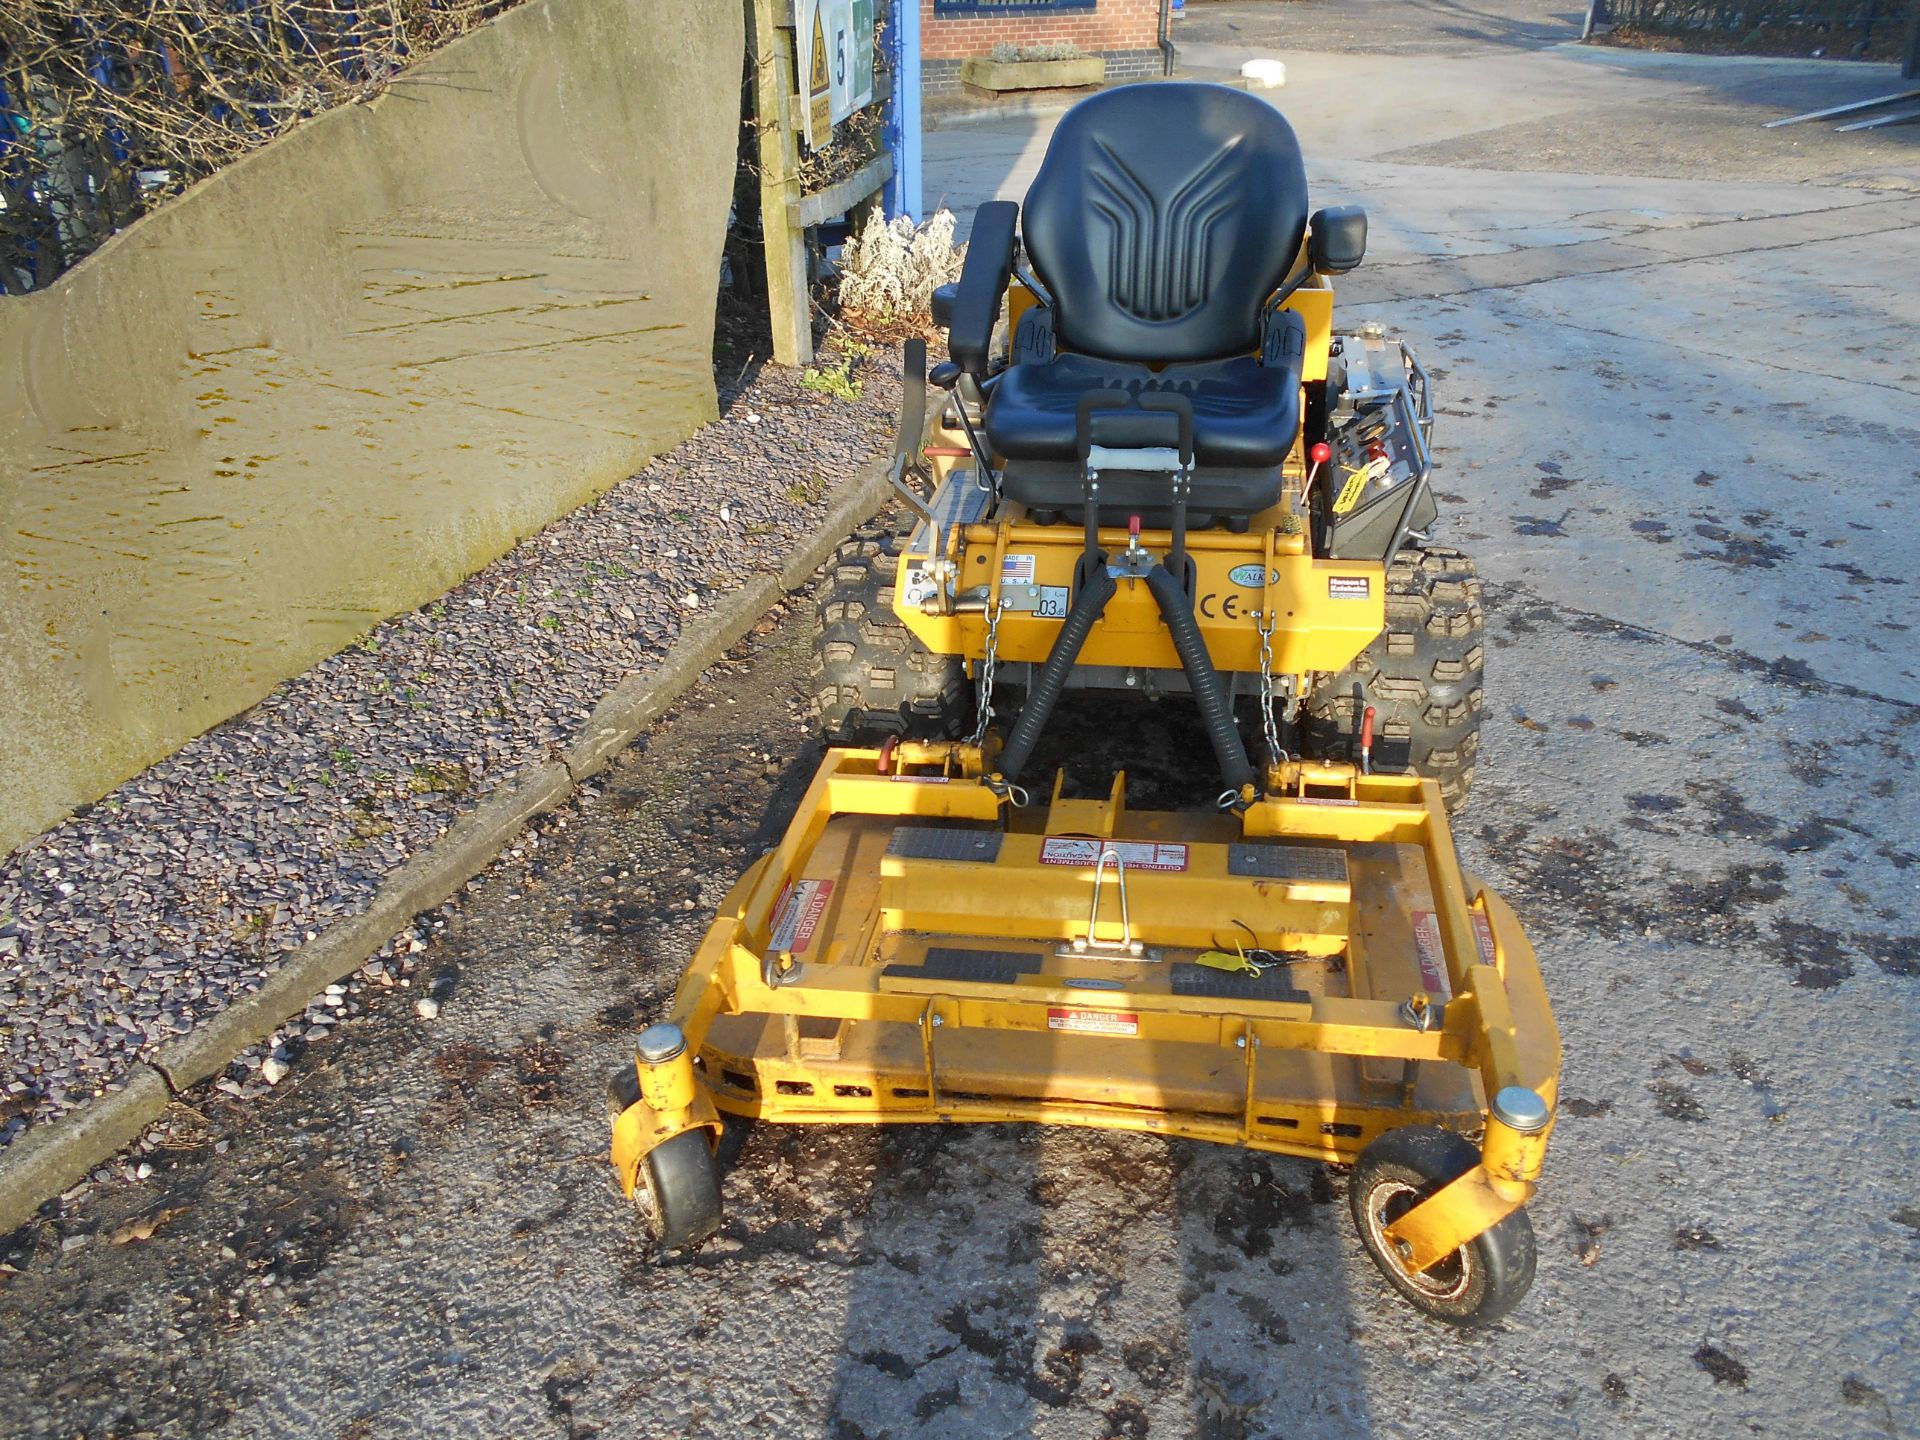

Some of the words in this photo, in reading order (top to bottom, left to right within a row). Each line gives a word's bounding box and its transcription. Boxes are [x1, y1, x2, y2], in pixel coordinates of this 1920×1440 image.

[837, 29, 845, 86] 5
[1200, 594, 1239, 619] CE
[1044, 858, 1098, 866] DJUSTMENT
[799, 900, 825, 939] DANGER
[1415, 926, 1434, 966] DANGER
[1080, 1011, 1118, 1022] DANGER
